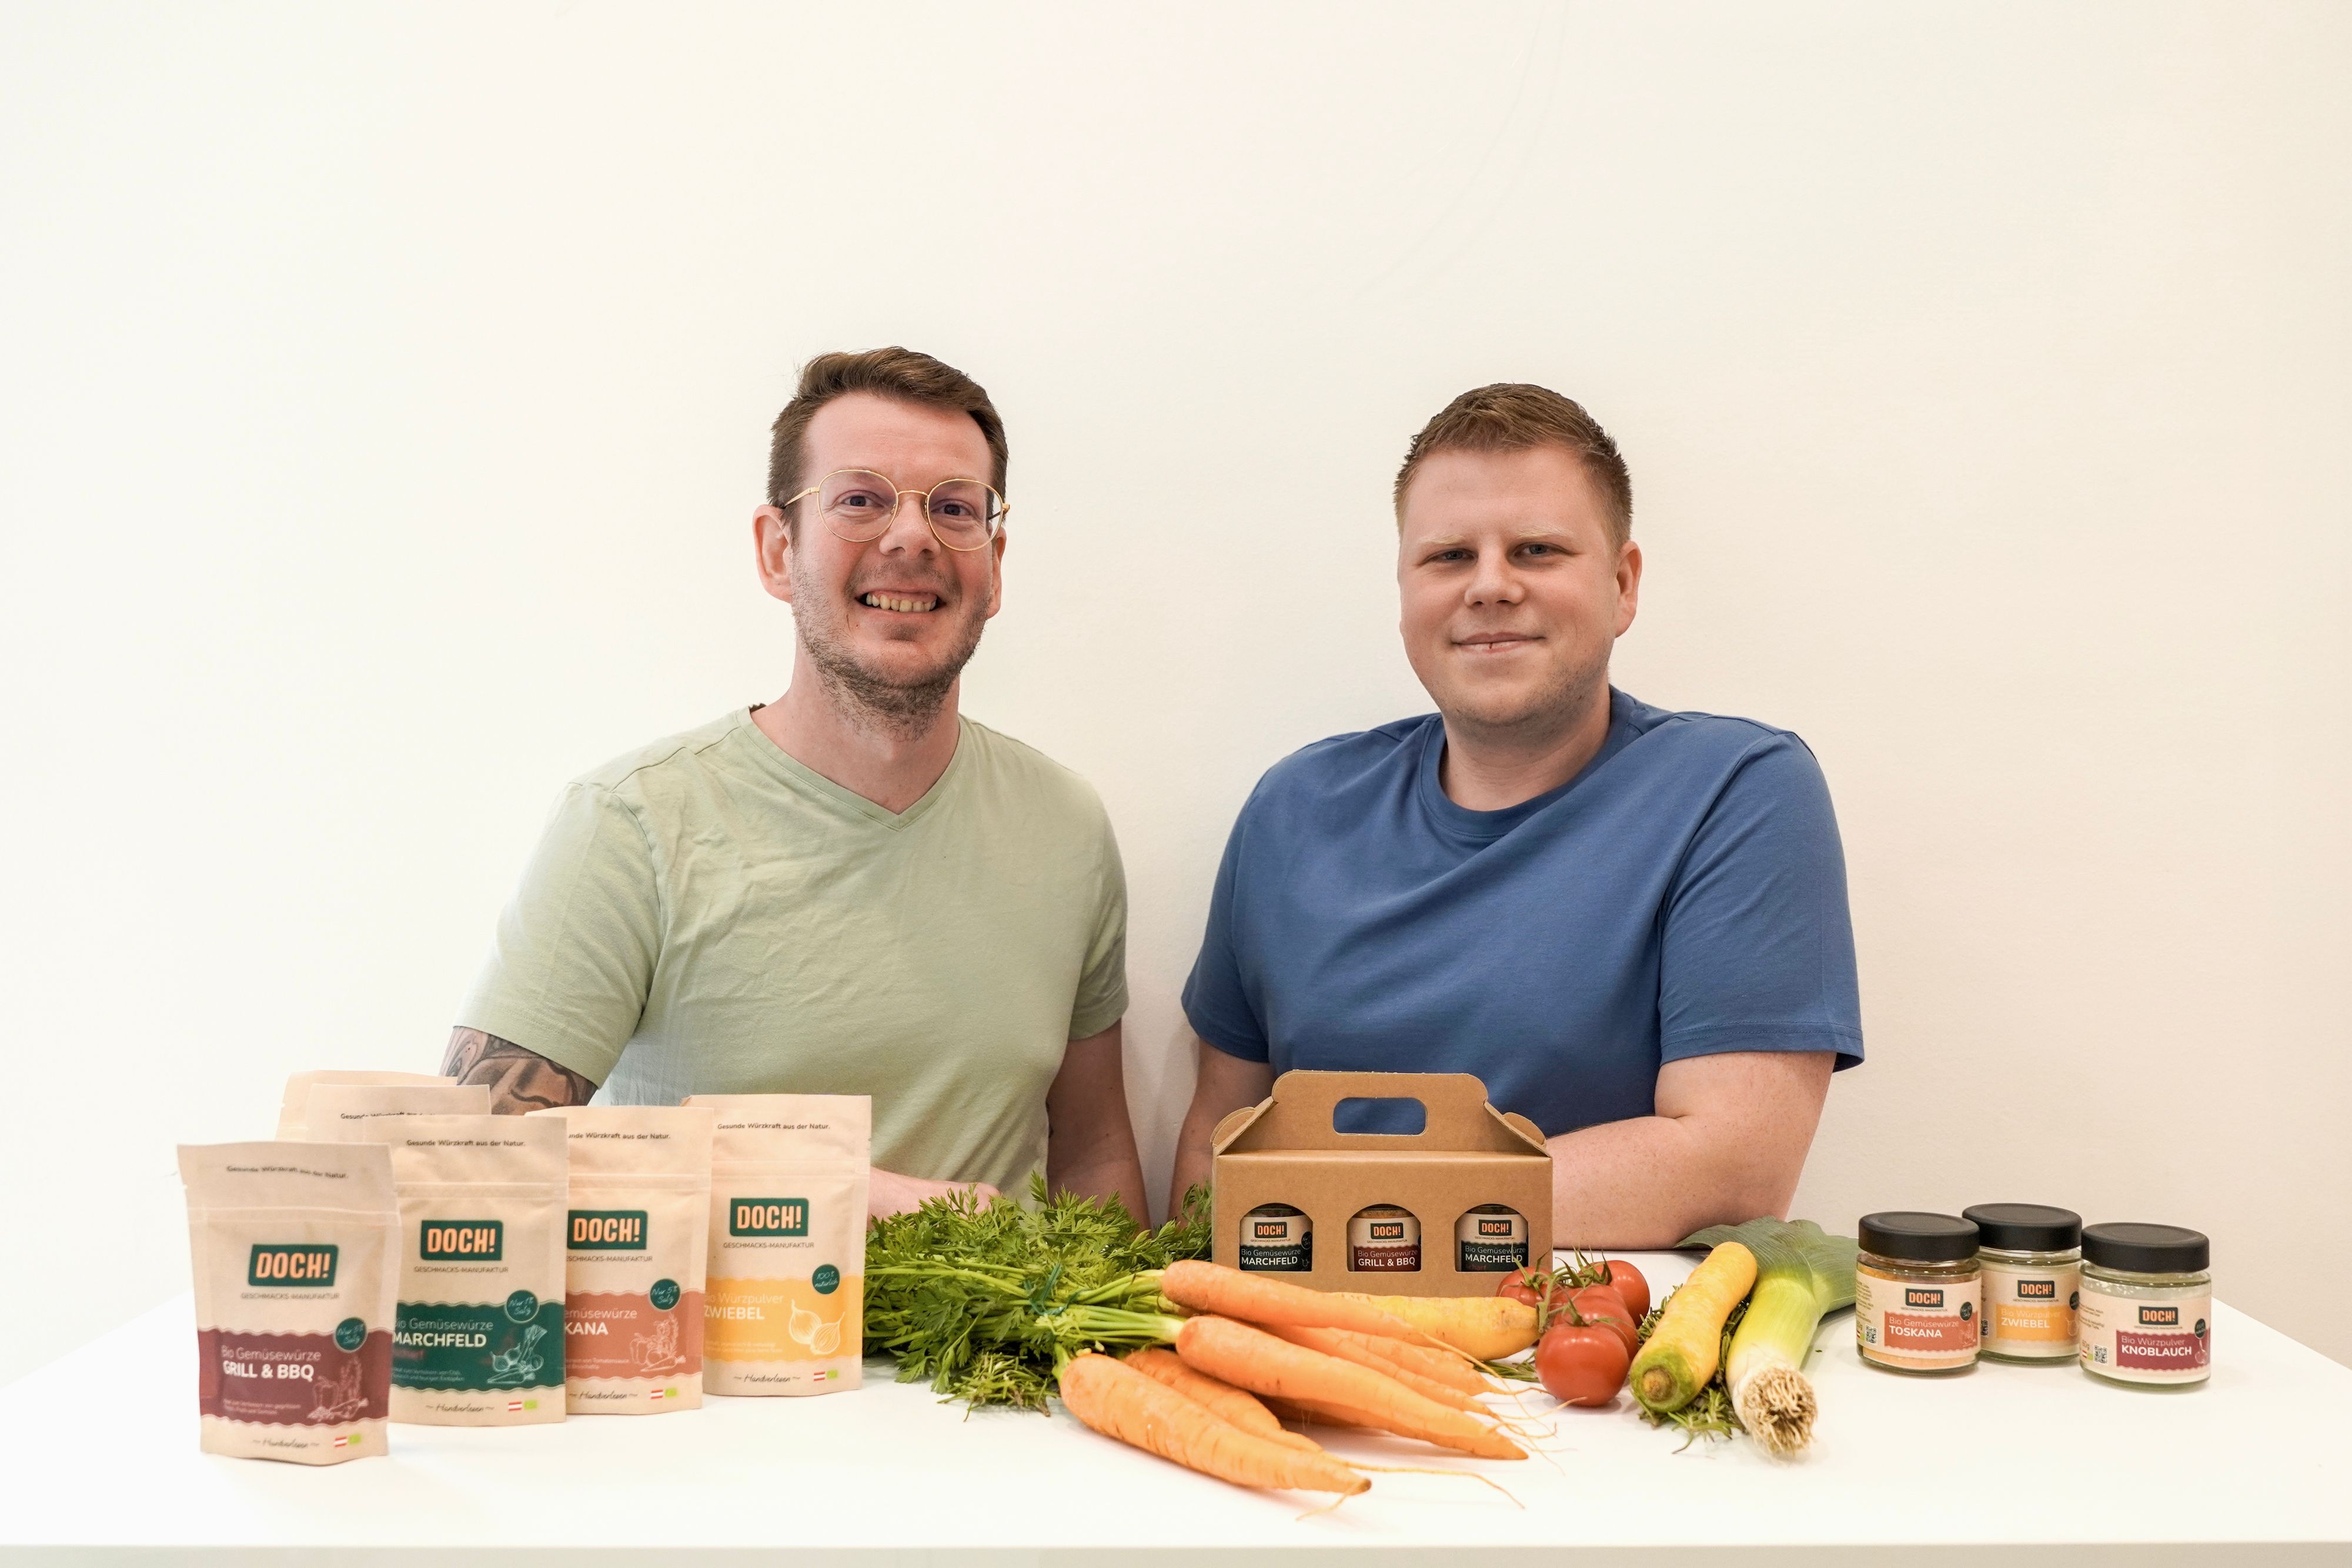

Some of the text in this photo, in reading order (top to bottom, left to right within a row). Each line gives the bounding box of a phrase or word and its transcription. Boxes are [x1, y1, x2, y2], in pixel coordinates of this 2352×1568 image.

[737, 1205, 801, 1229] DOCH!
[573, 1218, 640, 1242] DOCH!
[1257, 1225, 1284, 1235] DOCH!
[1373, 1226, 1401, 1236] DOCH!
[1482, 1222, 1509, 1233] DOCH!
[427, 1228, 496, 1253] DOCH!
[1477, 1246, 1526, 1254] Gemüsewürze
[1241, 1256, 1298, 1265] MARCHFELD
[1358, 1257, 1415, 1266] GRILL & BBQ
[1465, 1253, 1522, 1263] MARCHFELD
[255, 1252, 330, 1279] DOCH!
[2021, 1283, 2052, 1295] DOCH!
[1909, 1292, 1940, 1304] DOCH!
[703, 1305, 765, 1320] ZWIEBEL
[2001, 1308, 2014, 1316] Bio
[2142, 1310, 2176, 1322] DOCH!
[409, 1318, 494, 1330] Gemüsewürze
[1903, 1318, 1959, 1328] Gemüsewürze
[2001, 1318, 2050, 1328] ZWIEBEL
[1889, 1325, 1943, 1338] TOSKANA
[392, 1331, 487, 1348] MARCHFELD
[2121, 1335, 2185, 1346] Bio Würzpulver
[221, 1345, 321, 1361] Bio Gemüsewürze
[2122, 1345, 2192, 1357] KNOBLAUCH
[223, 1360, 315, 1382] GRILL & BBQ
[744, 1373, 791, 1383] Handverlesen
